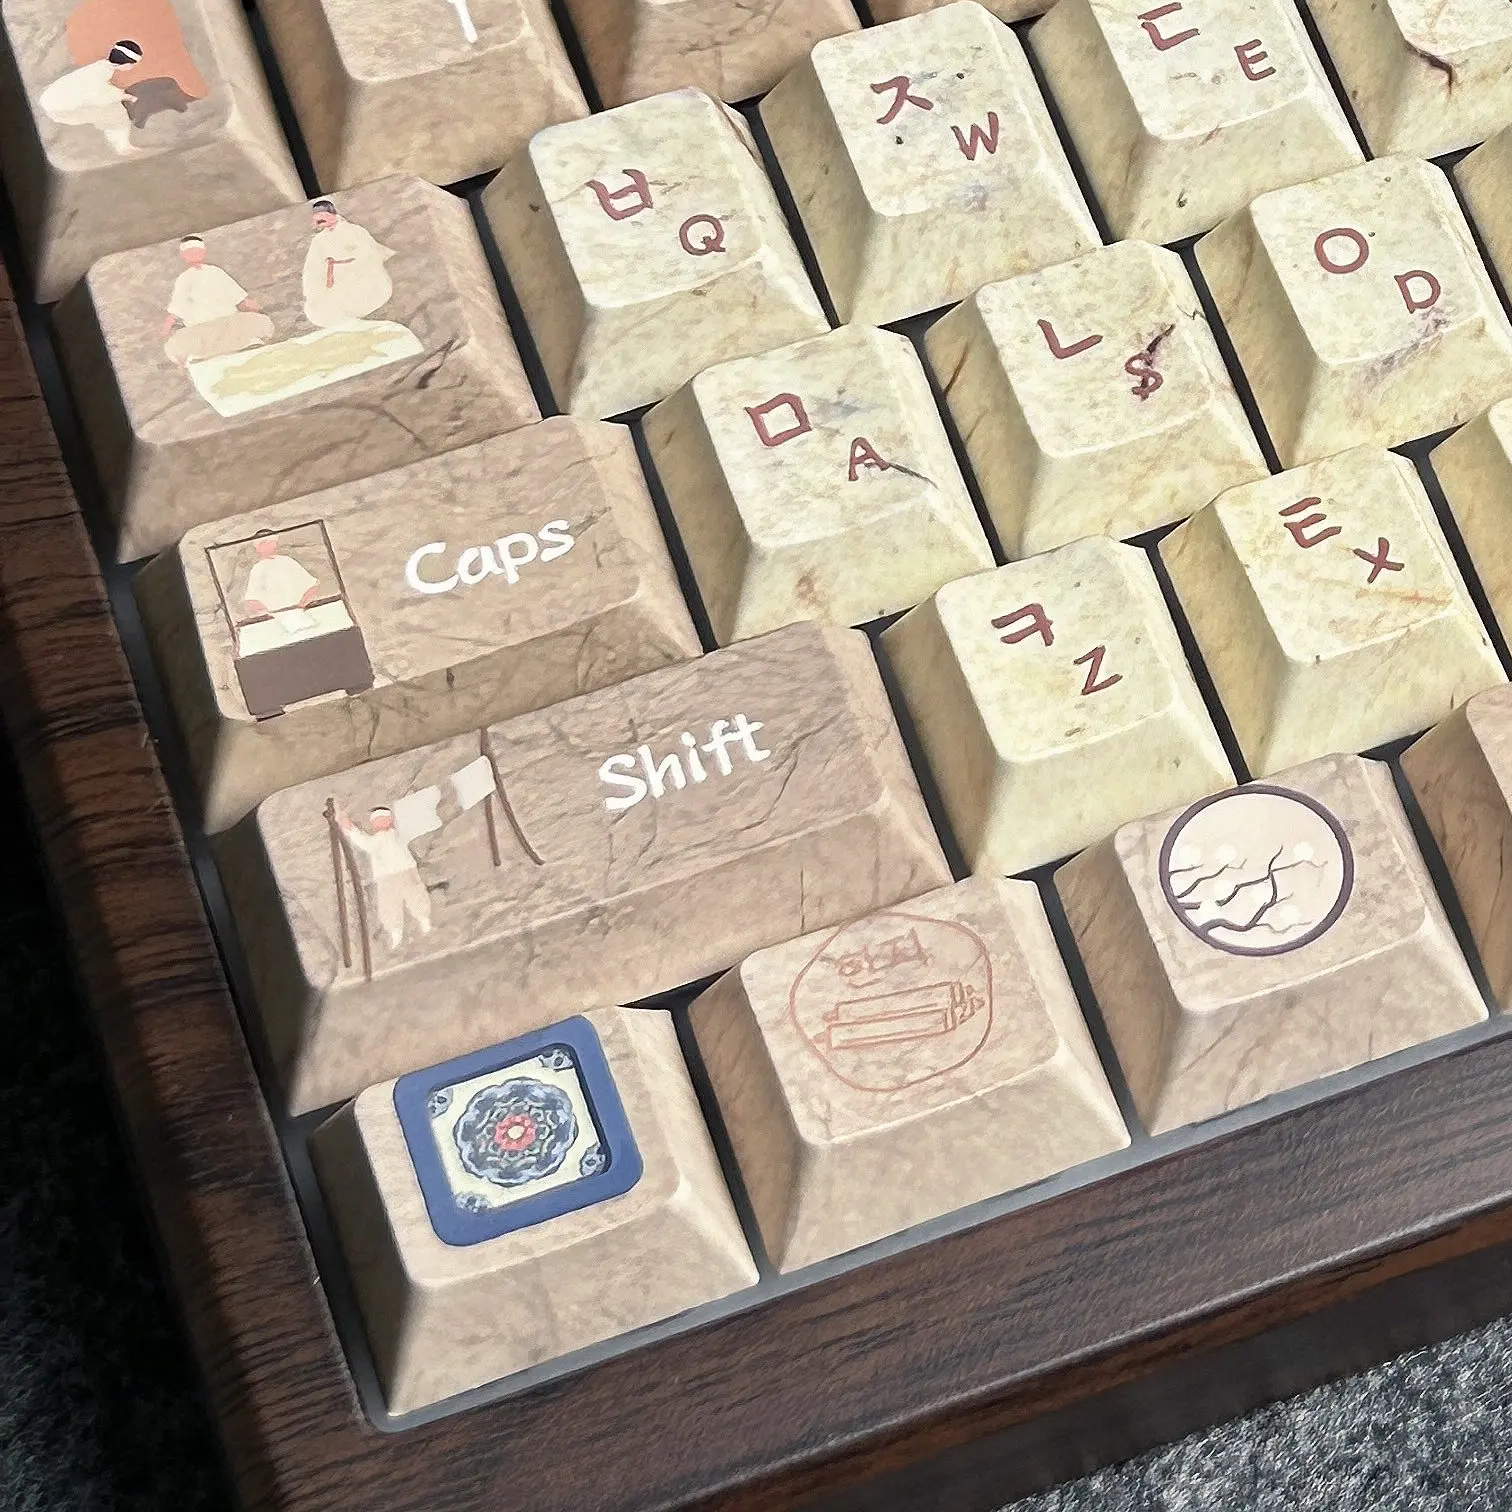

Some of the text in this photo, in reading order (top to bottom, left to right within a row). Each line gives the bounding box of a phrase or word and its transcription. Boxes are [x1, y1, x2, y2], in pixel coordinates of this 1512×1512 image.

[1234, 38, 1275, 81] E
[951, 111, 1000, 160] W
[679, 214, 725, 256] Q
[1394, 270, 1441, 315] D
[848, 437, 890, 481] A
[404, 518, 577, 594] Caps
[1353, 537, 1405, 584] X
[1073, 646, 1123, 696] Z
[599, 711, 772, 813] Shift
